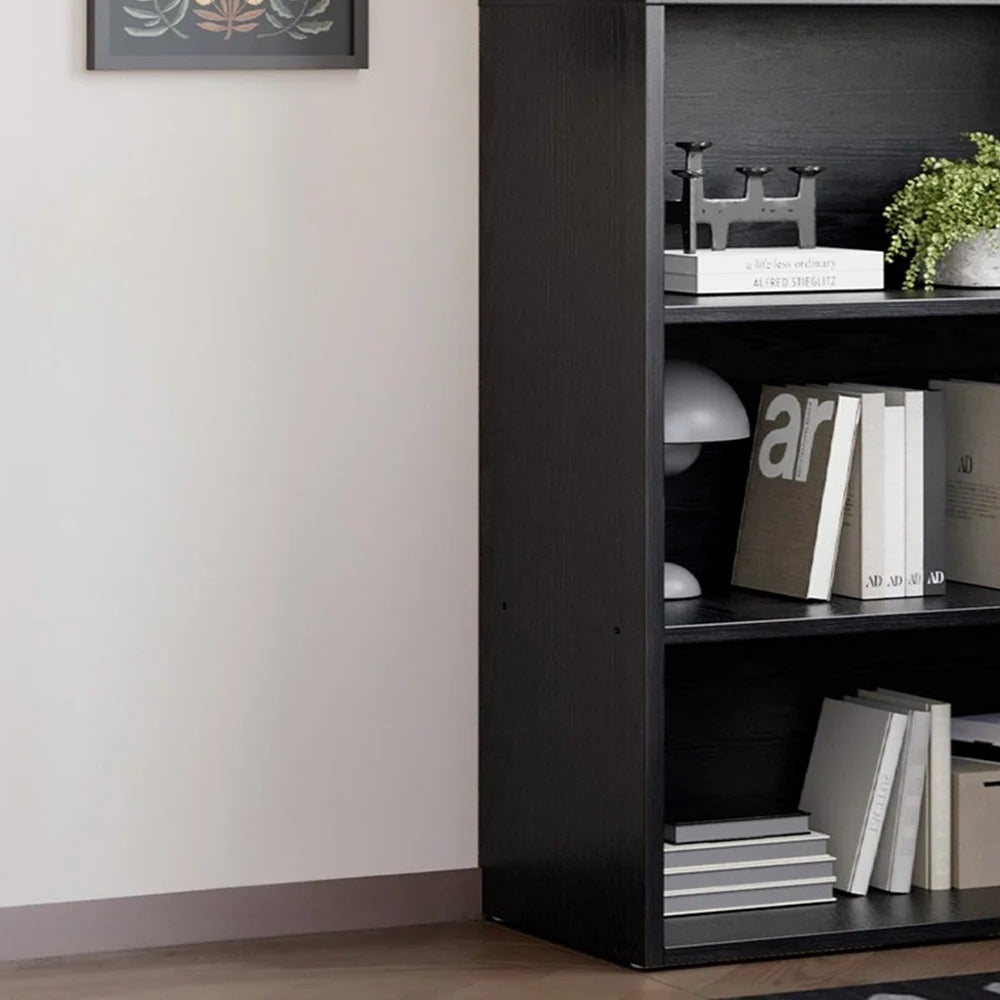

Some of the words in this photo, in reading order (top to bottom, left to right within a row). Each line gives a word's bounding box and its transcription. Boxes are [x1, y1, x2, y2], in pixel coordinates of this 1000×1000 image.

[755, 258, 771, 270] life
[774, 258, 792, 269] less
[794, 258, 836, 271] ordinary
[753, 276, 789, 288] ALFRED
[791, 275, 836, 288] STIEGLITZ
[758, 393, 836, 482] ar
[957, 454, 973, 474] AD
[865, 575, 883, 588] AD
[886, 575, 903, 588] AD
[927, 571, 945, 585] AD
